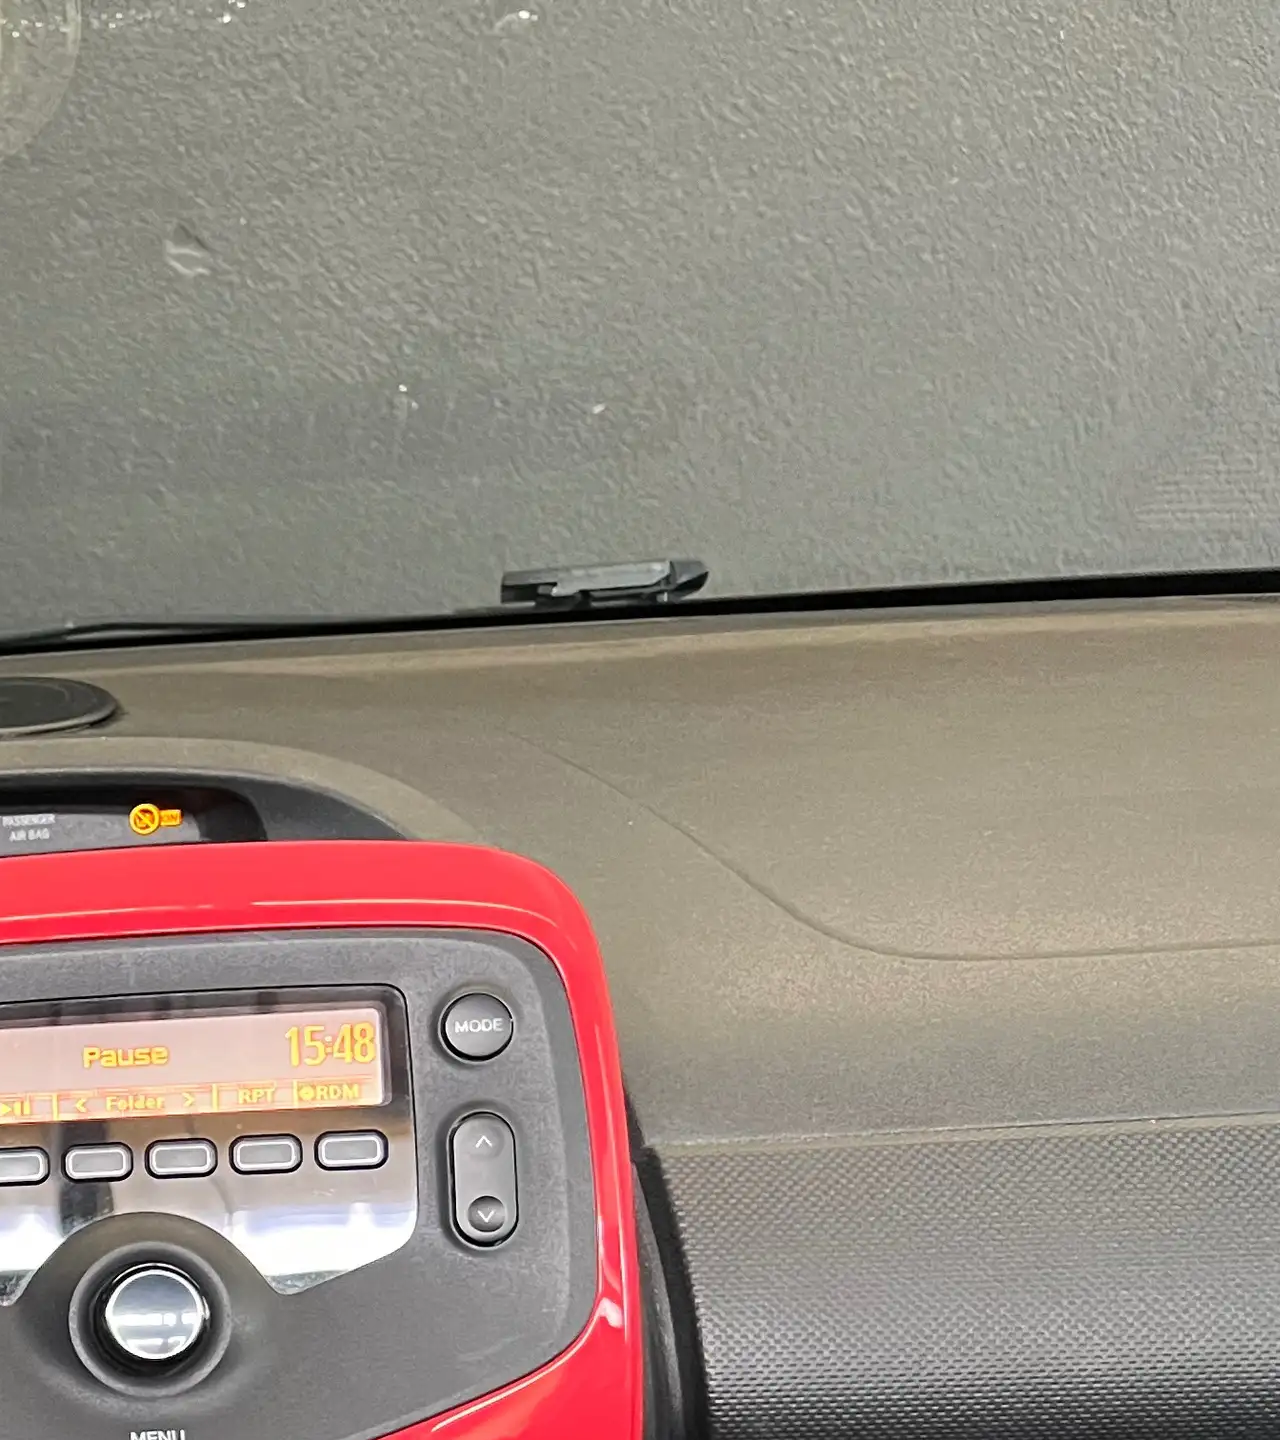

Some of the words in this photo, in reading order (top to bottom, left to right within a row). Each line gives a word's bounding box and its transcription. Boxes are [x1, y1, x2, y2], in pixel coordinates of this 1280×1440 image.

[454, 1017, 504, 1033] MODE
[284, 1020, 376, 1067] 15:48
[82, 1045, 169, 1069] Pause
[237, 1086, 274, 1104] RPT
[315, 1083, 360, 1101] RDM
[105, 1094, 166, 1113] Folder
